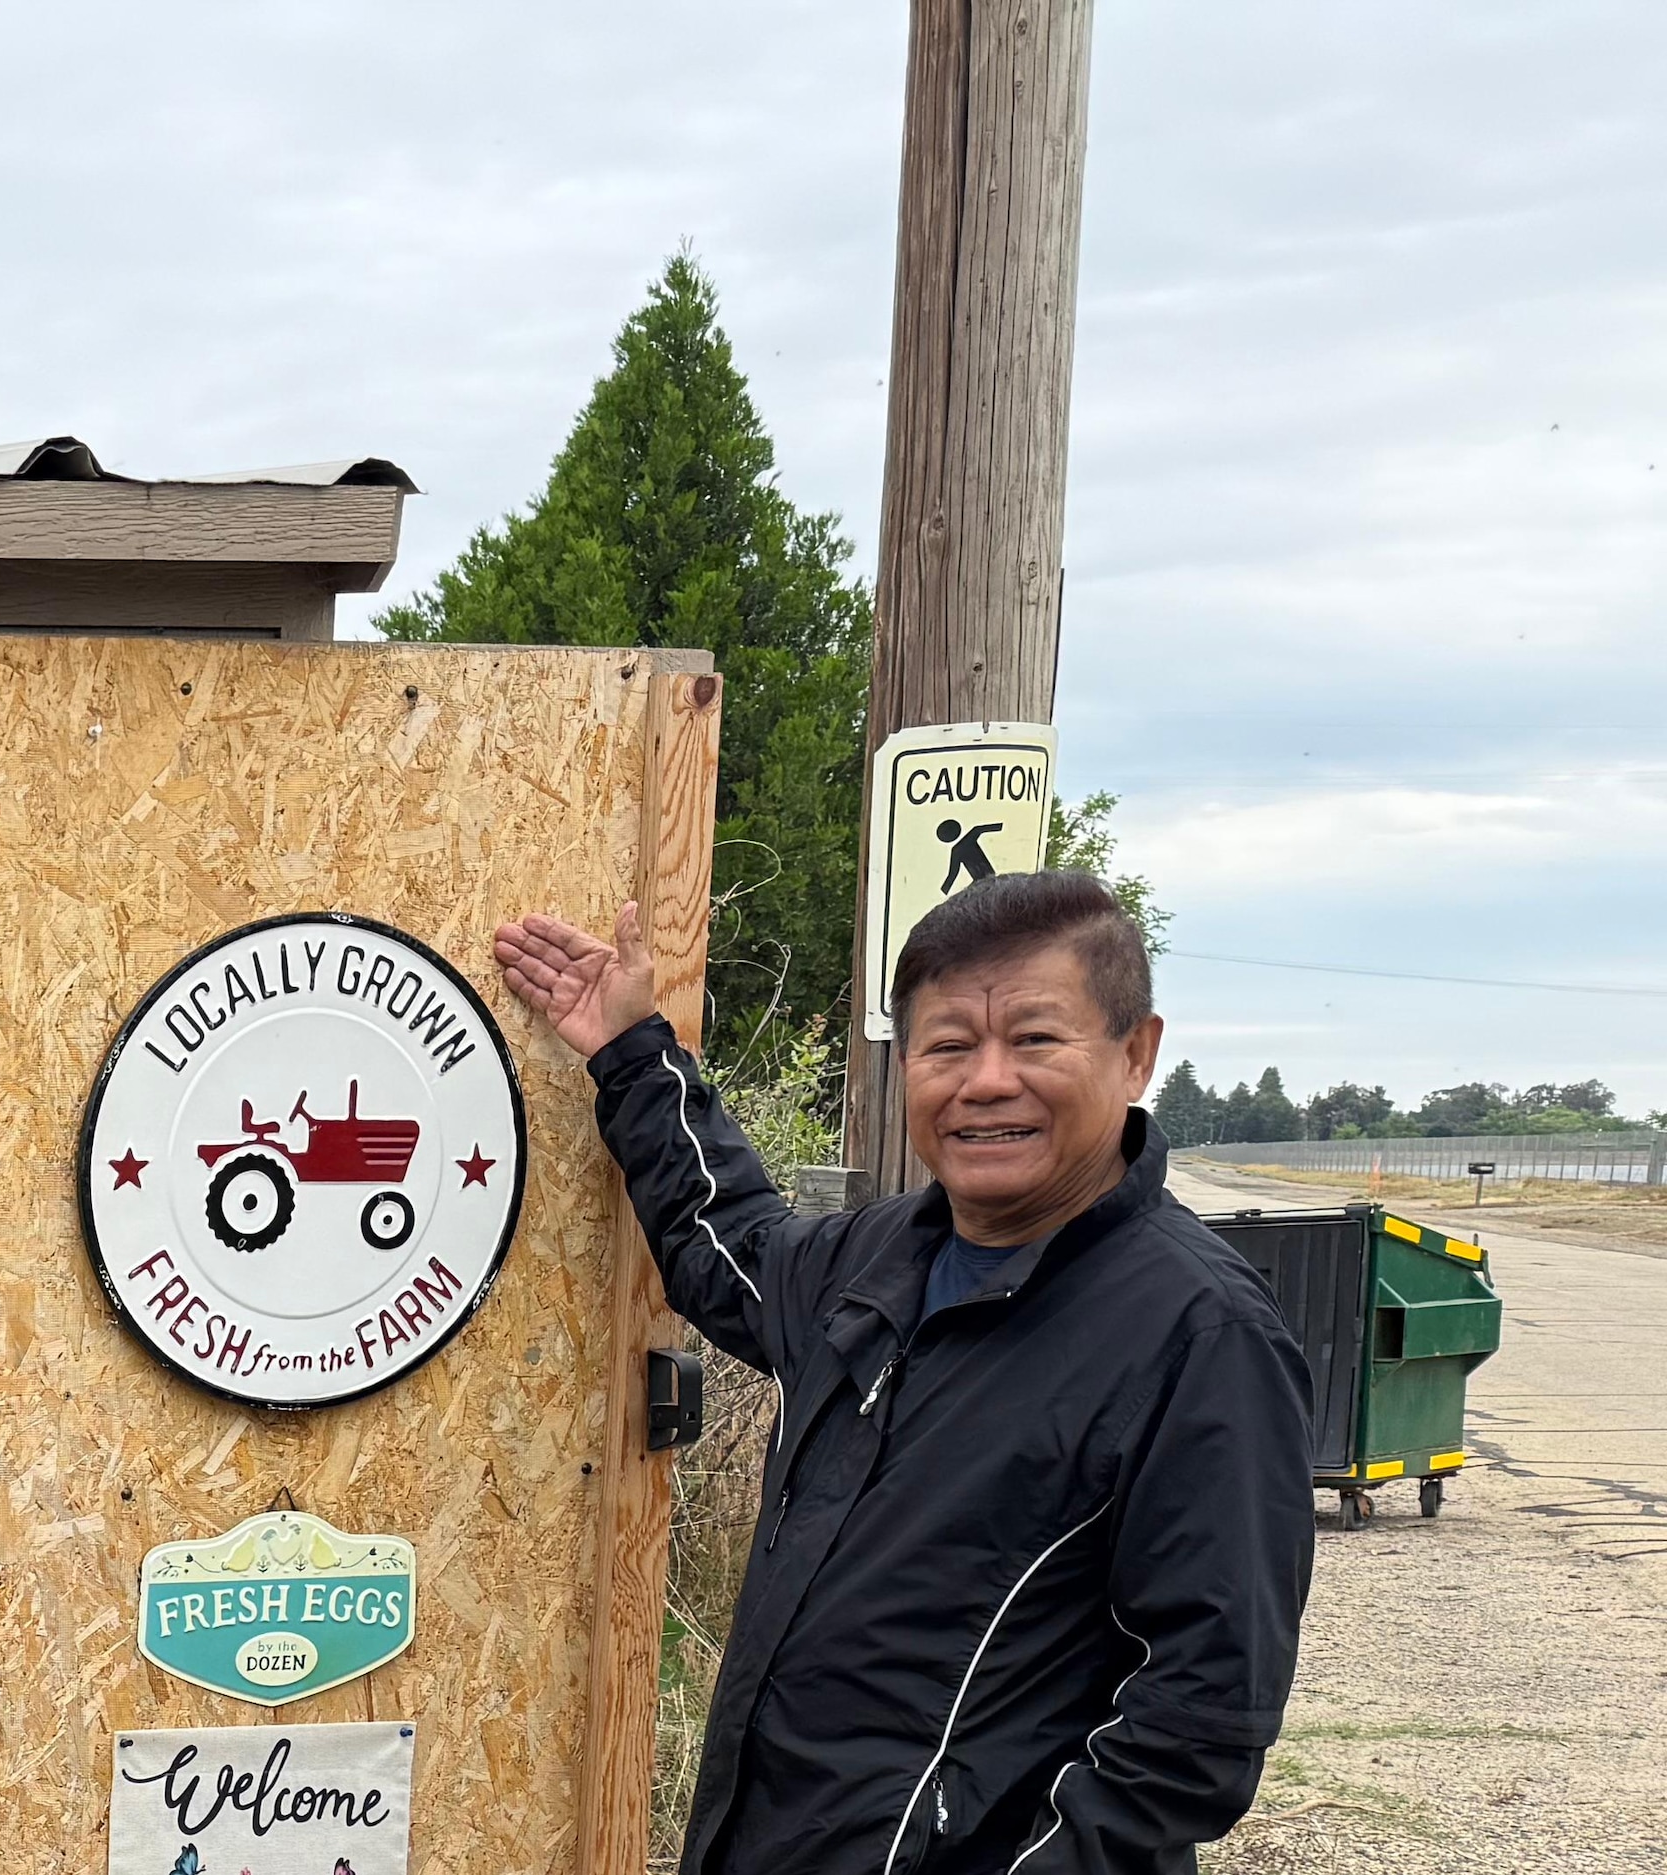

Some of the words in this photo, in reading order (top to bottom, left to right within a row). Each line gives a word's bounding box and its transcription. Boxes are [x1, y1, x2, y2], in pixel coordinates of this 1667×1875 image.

[907, 765, 1041, 805] CAUTION
[145, 941, 325, 1073] LOCALLY
[337, 945, 475, 1074] GROWN
[127, 1249, 252, 1376] FRESH
[242, 1344, 313, 1376] from
[319, 1347, 355, 1371] the
[355, 1257, 463, 1367] FARM
[155, 1583, 290, 1639] FRESH
[300, 1584, 403, 1630] EGGS
[246, 1654, 307, 1671] DOZEN
[258, 1640, 273, 1654] by
[121, 1739, 392, 1838] Welcome
